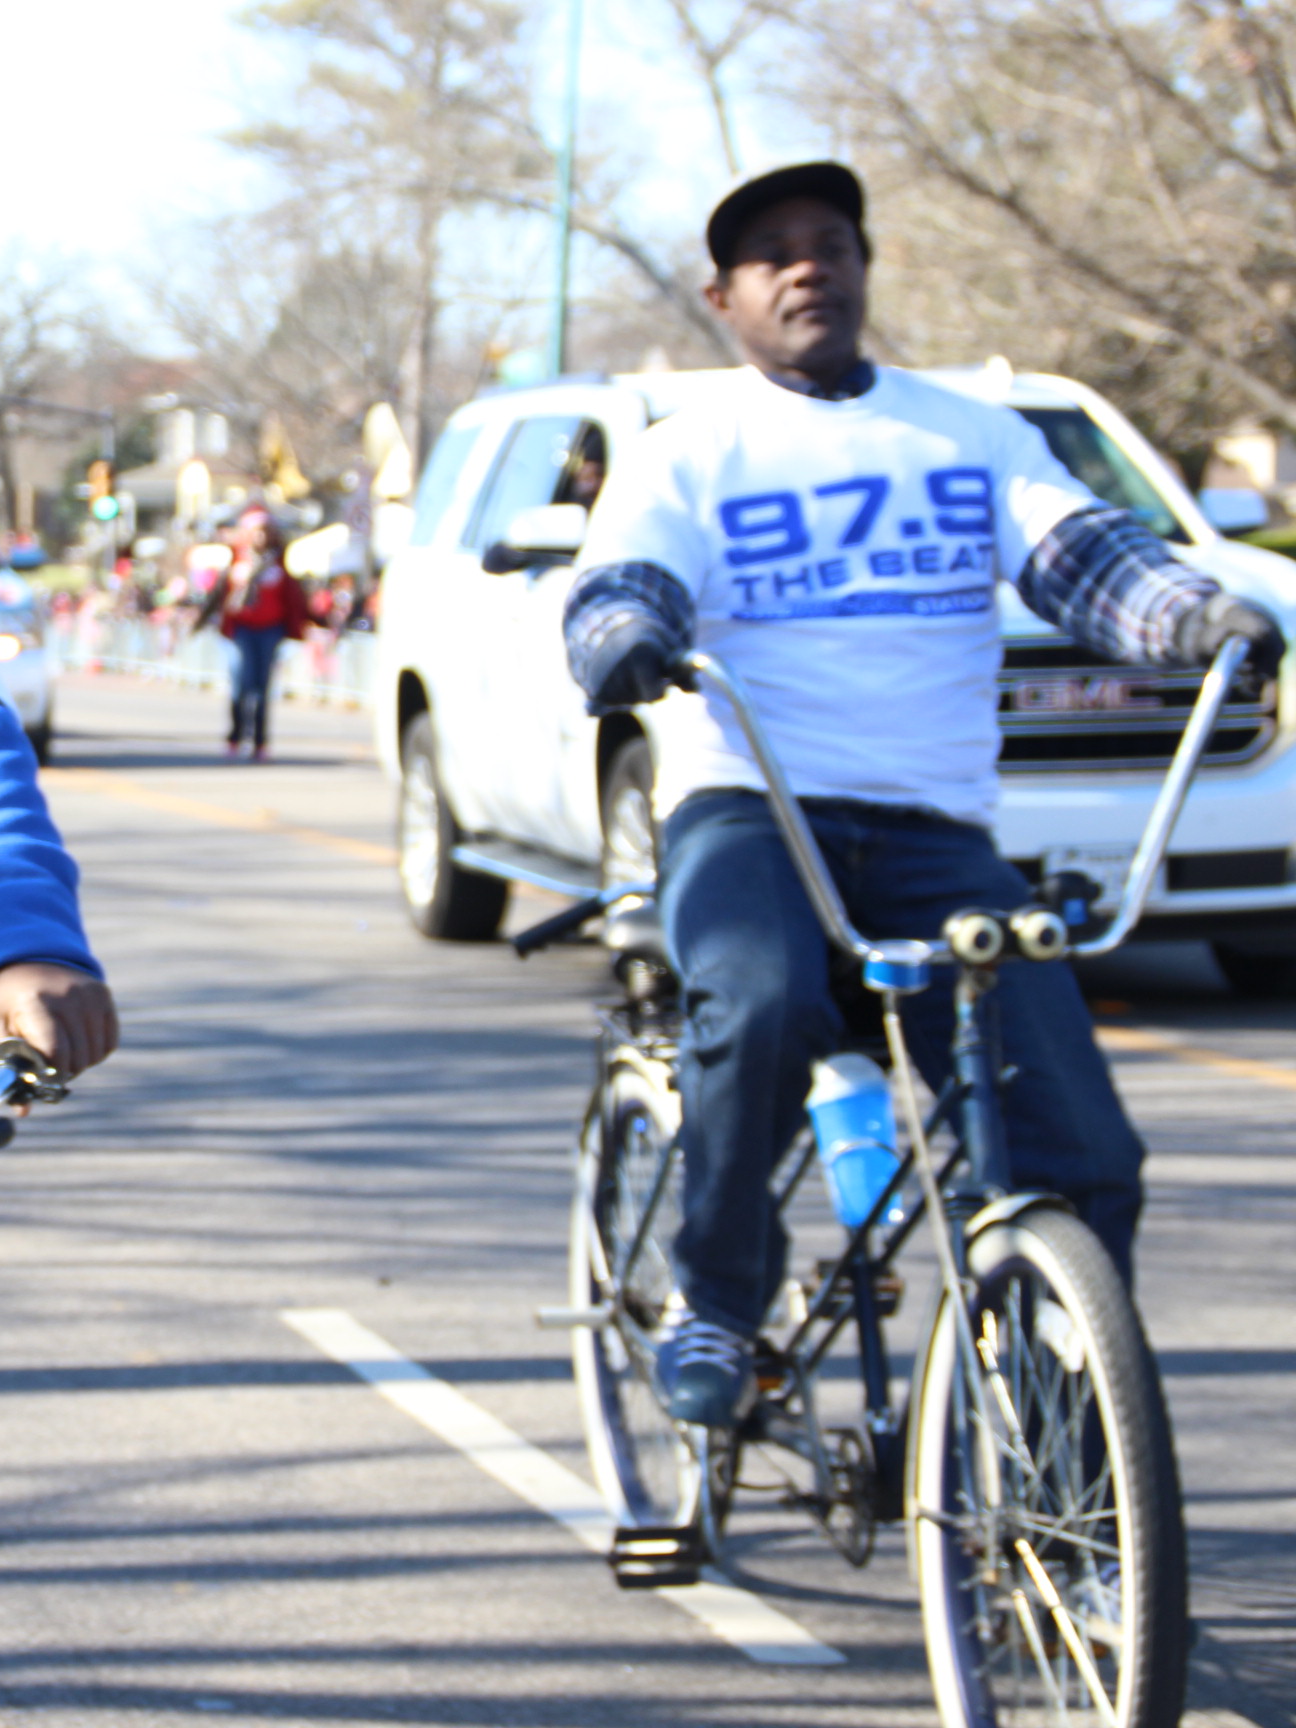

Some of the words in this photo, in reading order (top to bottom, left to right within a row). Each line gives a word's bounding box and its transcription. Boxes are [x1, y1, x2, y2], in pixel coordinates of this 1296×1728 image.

[720, 468, 995, 566] 97.9
[732, 560, 846, 602] THE
[1016, 677, 1164, 711] GMC
